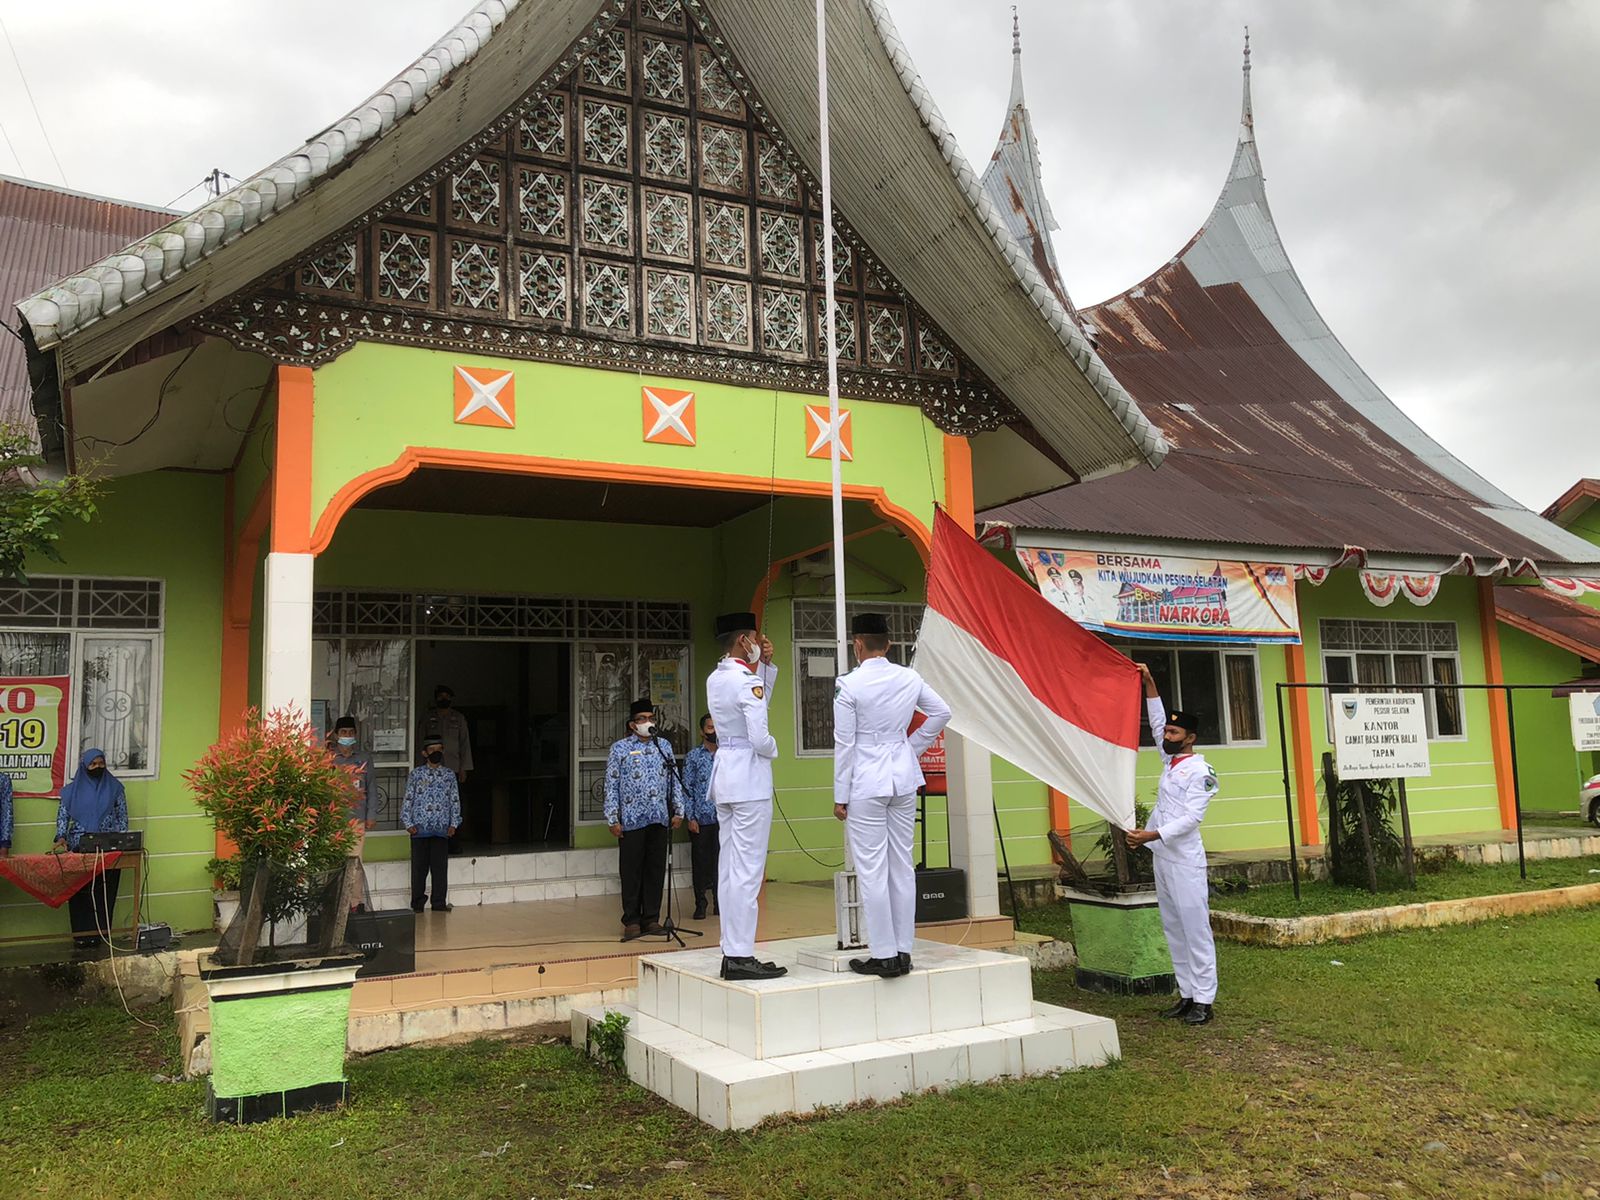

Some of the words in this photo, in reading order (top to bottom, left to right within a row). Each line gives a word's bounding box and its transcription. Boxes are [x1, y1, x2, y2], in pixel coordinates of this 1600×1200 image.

[1097, 554, 1162, 570] BERSAMA
[1098, 569, 1117, 582] KITA
[1118, 571, 1164, 586] WUJUDKAN
[1164, 574, 1193, 587] PESISIR
[1194, 575, 1228, 589] SELATAN
[1134, 587, 1174, 603] Bersih
[1158, 604, 1231, 627] NARKOBA
[1391, 707, 1410, 715] SELATAN
[1364, 721, 1399, 731] KANTOR
[1345, 735, 1364, 745] CAMAT
[1365, 735, 1380, 745] BASA
[1380, 734, 1400, 744] AMPEK
[1400, 734, 1418, 744] BALAI
[20, 753, 51, 768] TAPAN
[1372, 749, 1396, 758] TAPAN
